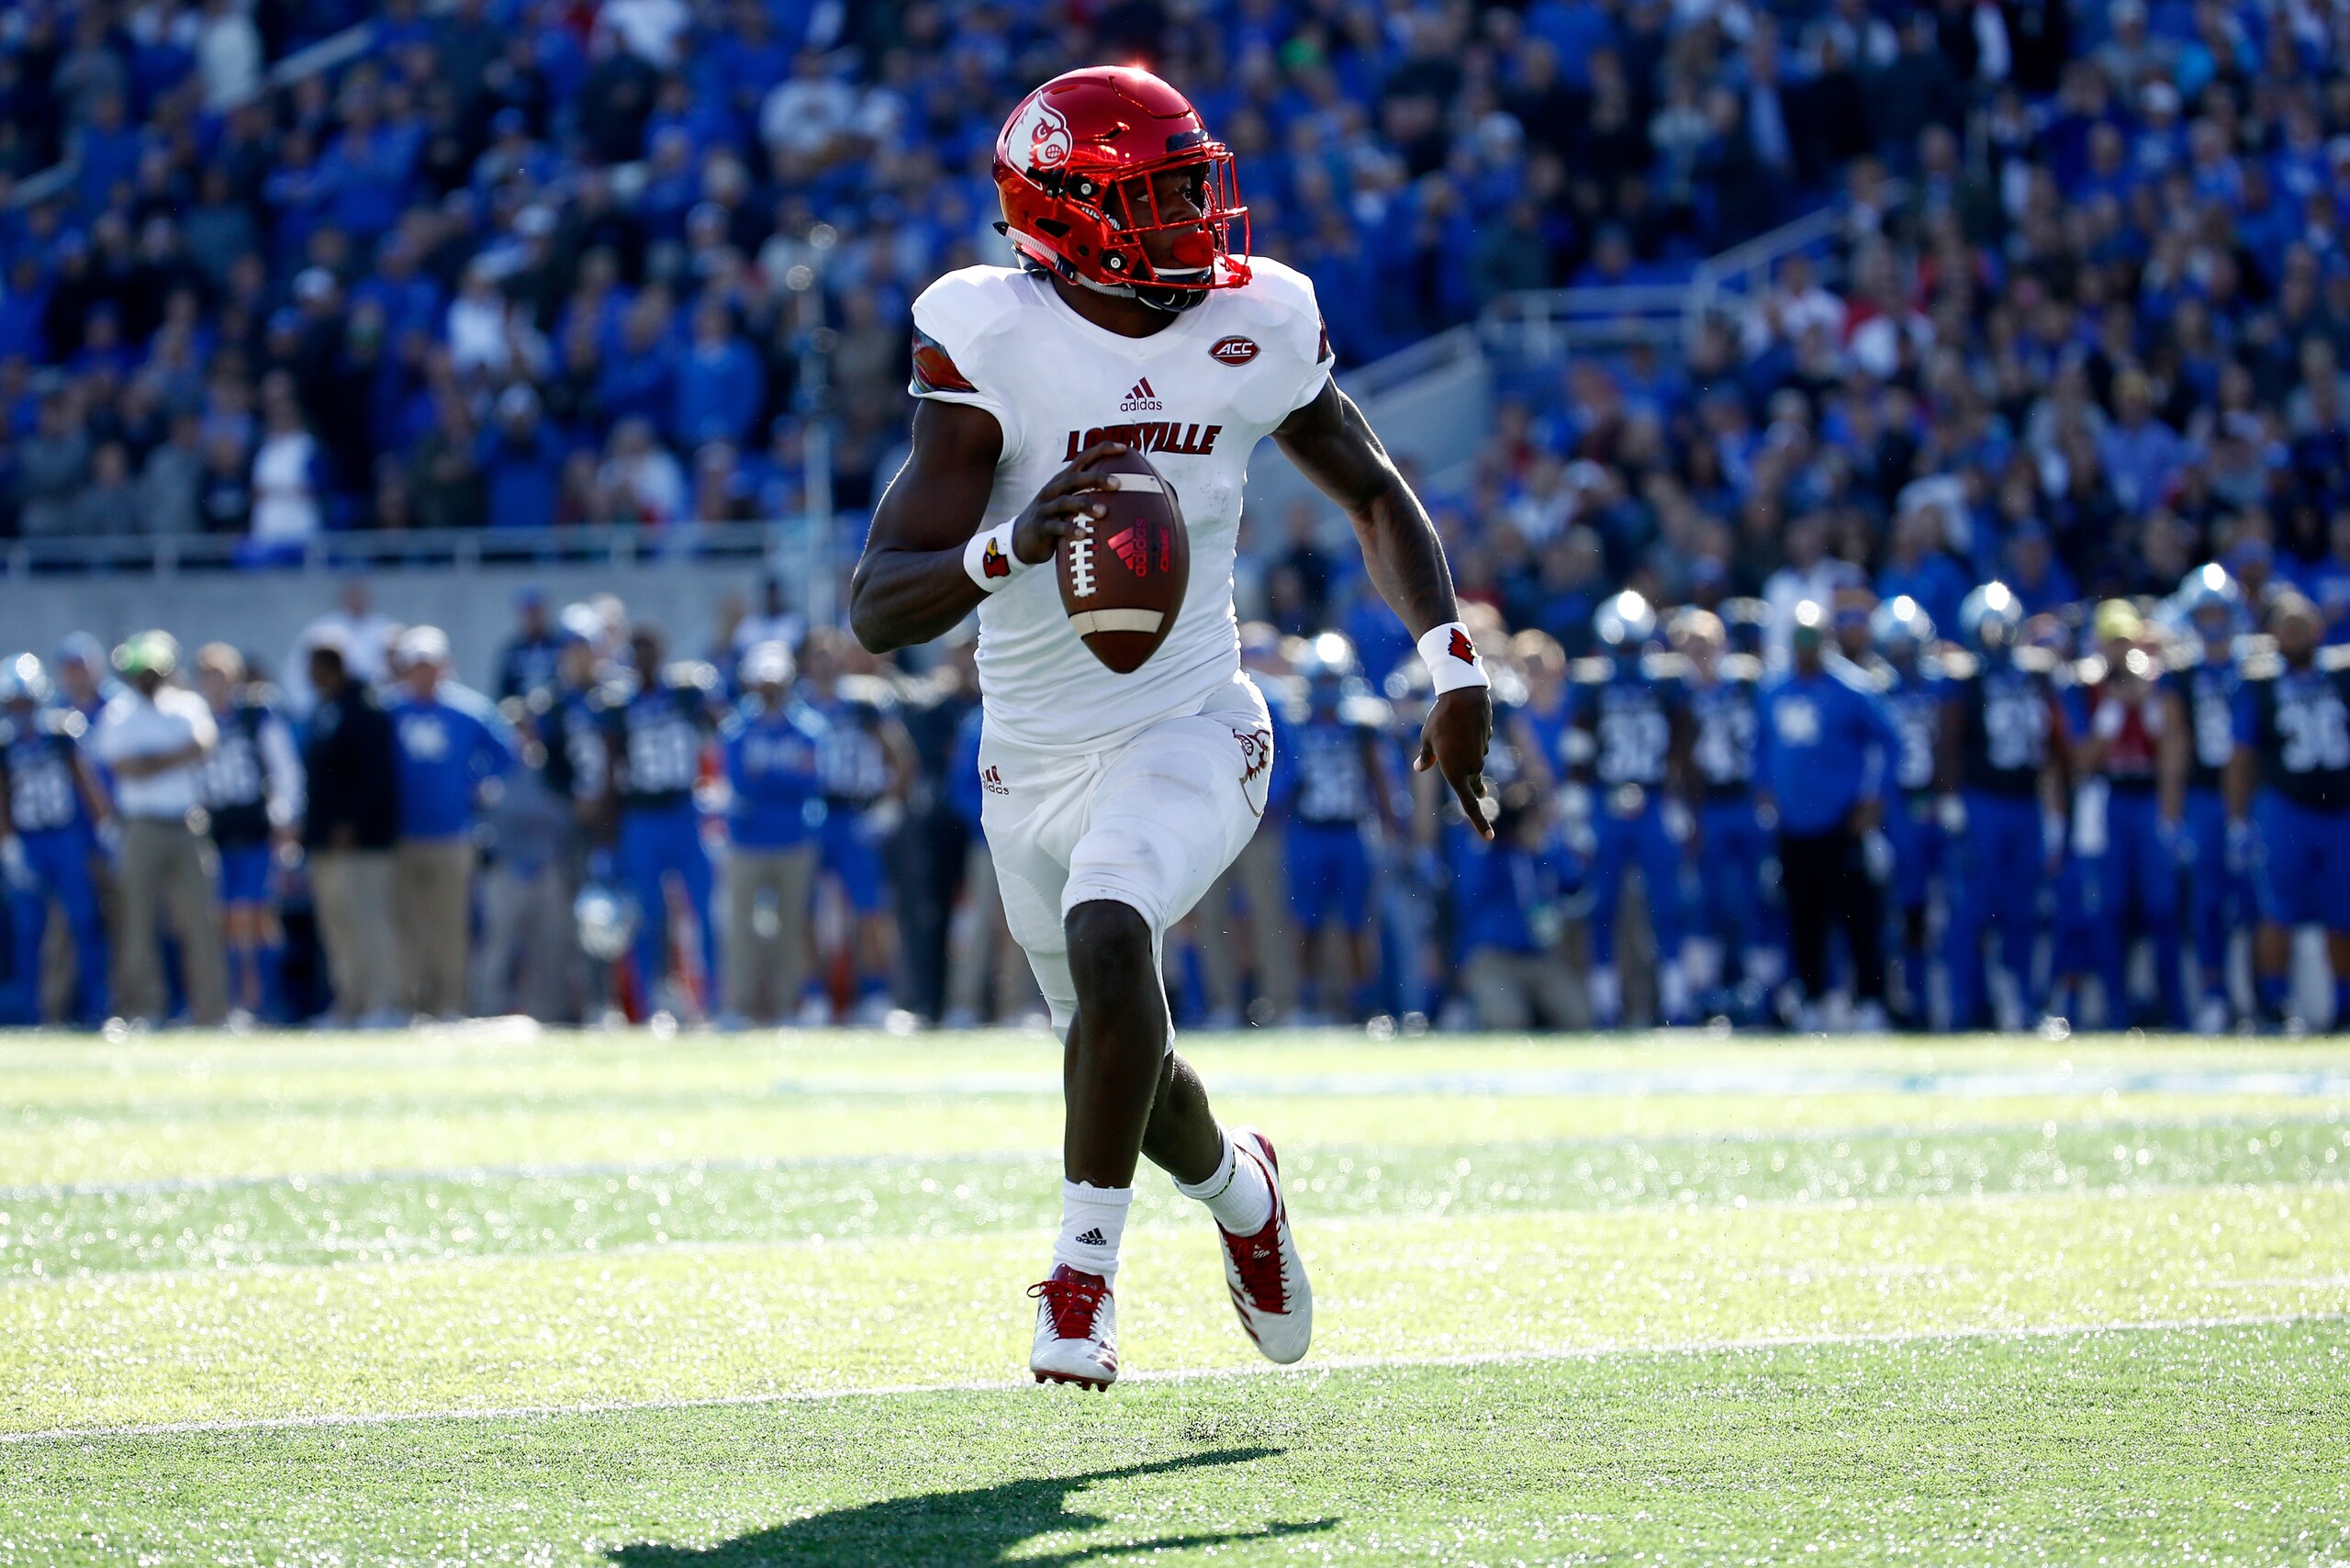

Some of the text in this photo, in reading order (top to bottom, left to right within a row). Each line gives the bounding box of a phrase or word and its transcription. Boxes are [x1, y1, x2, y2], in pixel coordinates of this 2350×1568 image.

[1215, 342, 1254, 355] ACC
[1120, 398, 1163, 412] adidas
[1133, 517, 1147, 577] adidas
[1075, 1236, 1107, 1246] adidas
